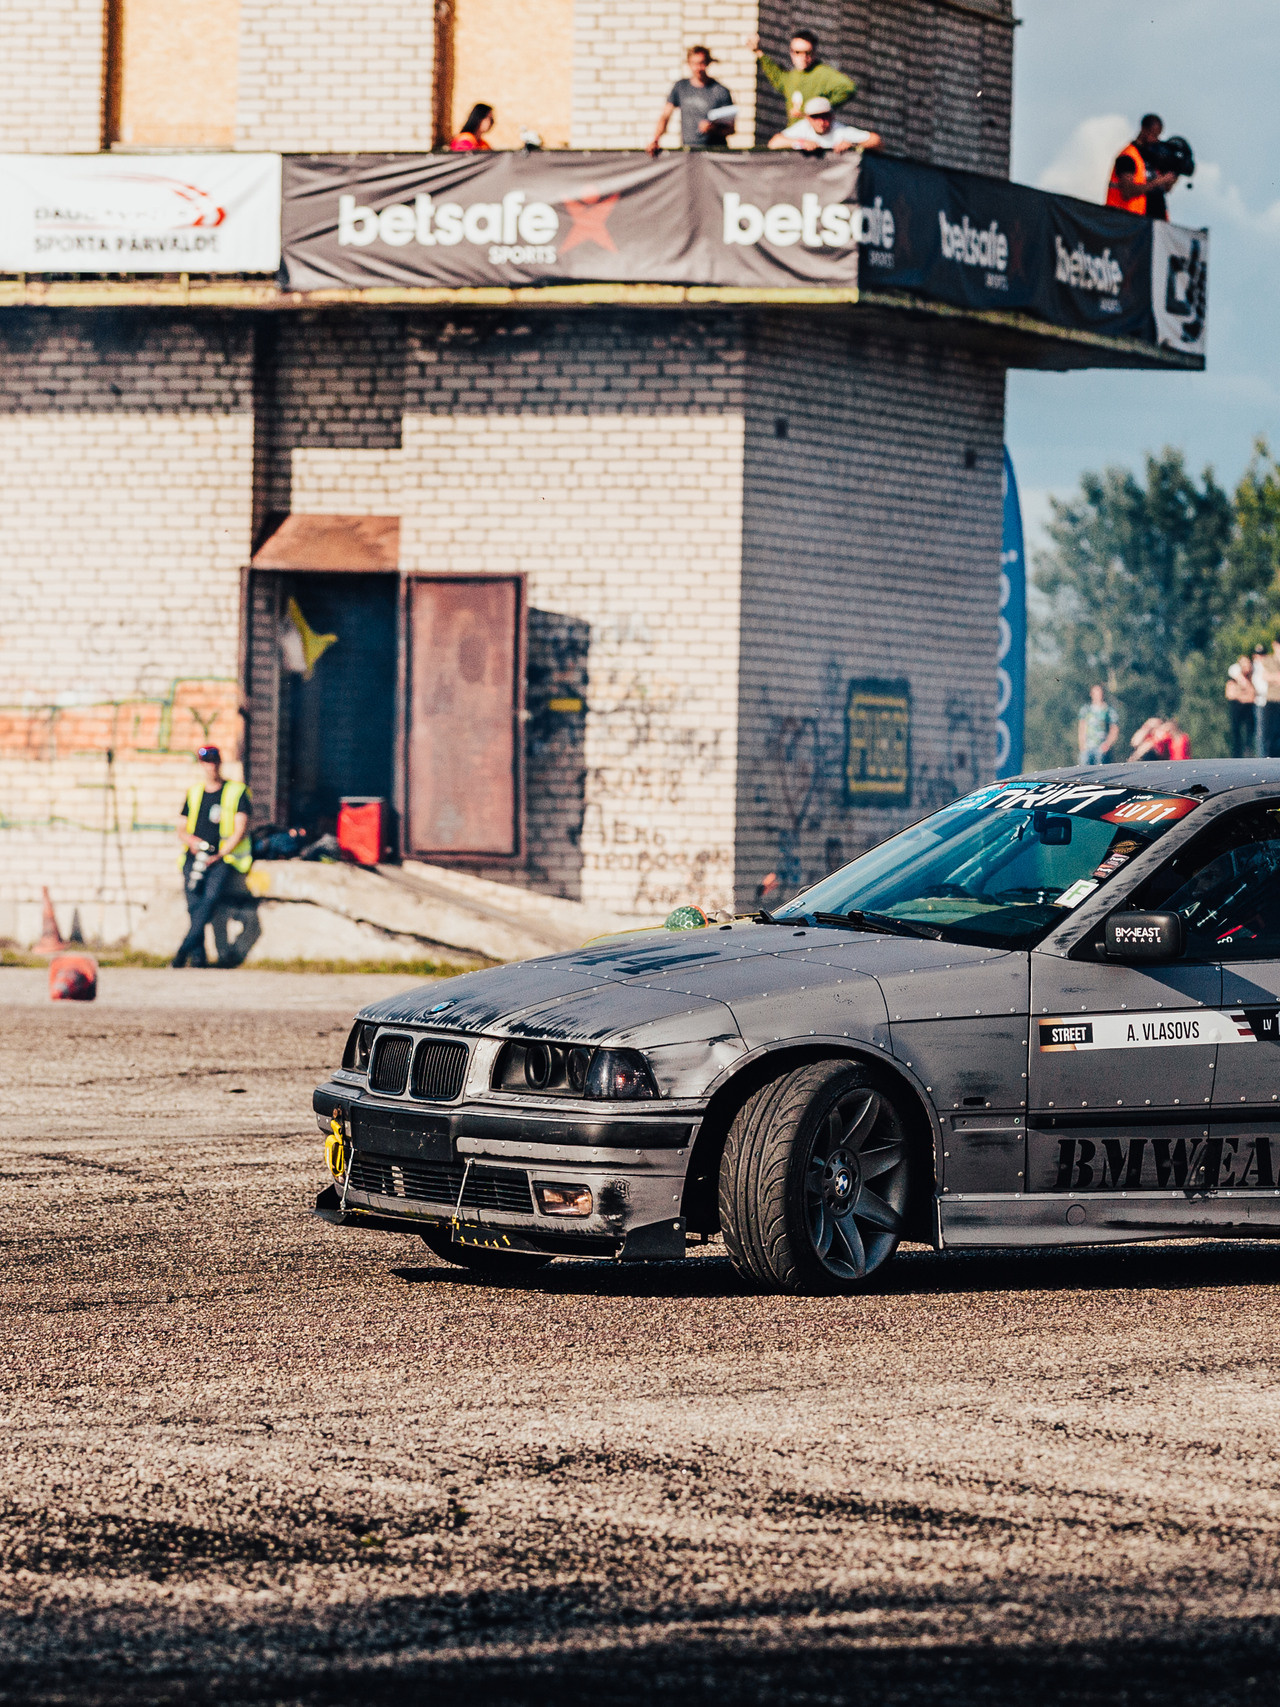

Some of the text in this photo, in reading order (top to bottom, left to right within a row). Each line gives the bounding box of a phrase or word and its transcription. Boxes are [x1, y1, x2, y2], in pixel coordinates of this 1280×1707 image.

[338, 190, 560, 247] betsafe
[722, 191, 896, 250] betsafe
[938, 210, 1010, 272] betsafe
[488, 245, 557, 265] SPORTS
[1054, 234, 1124, 297] betsafe
[1115, 927, 1161, 937] BMWEAST
[1052, 1026, 1087, 1042] STREET
[1127, 1021, 1200, 1042] A. VLASOVS
[1263, 1019, 1272, 1031] LV
